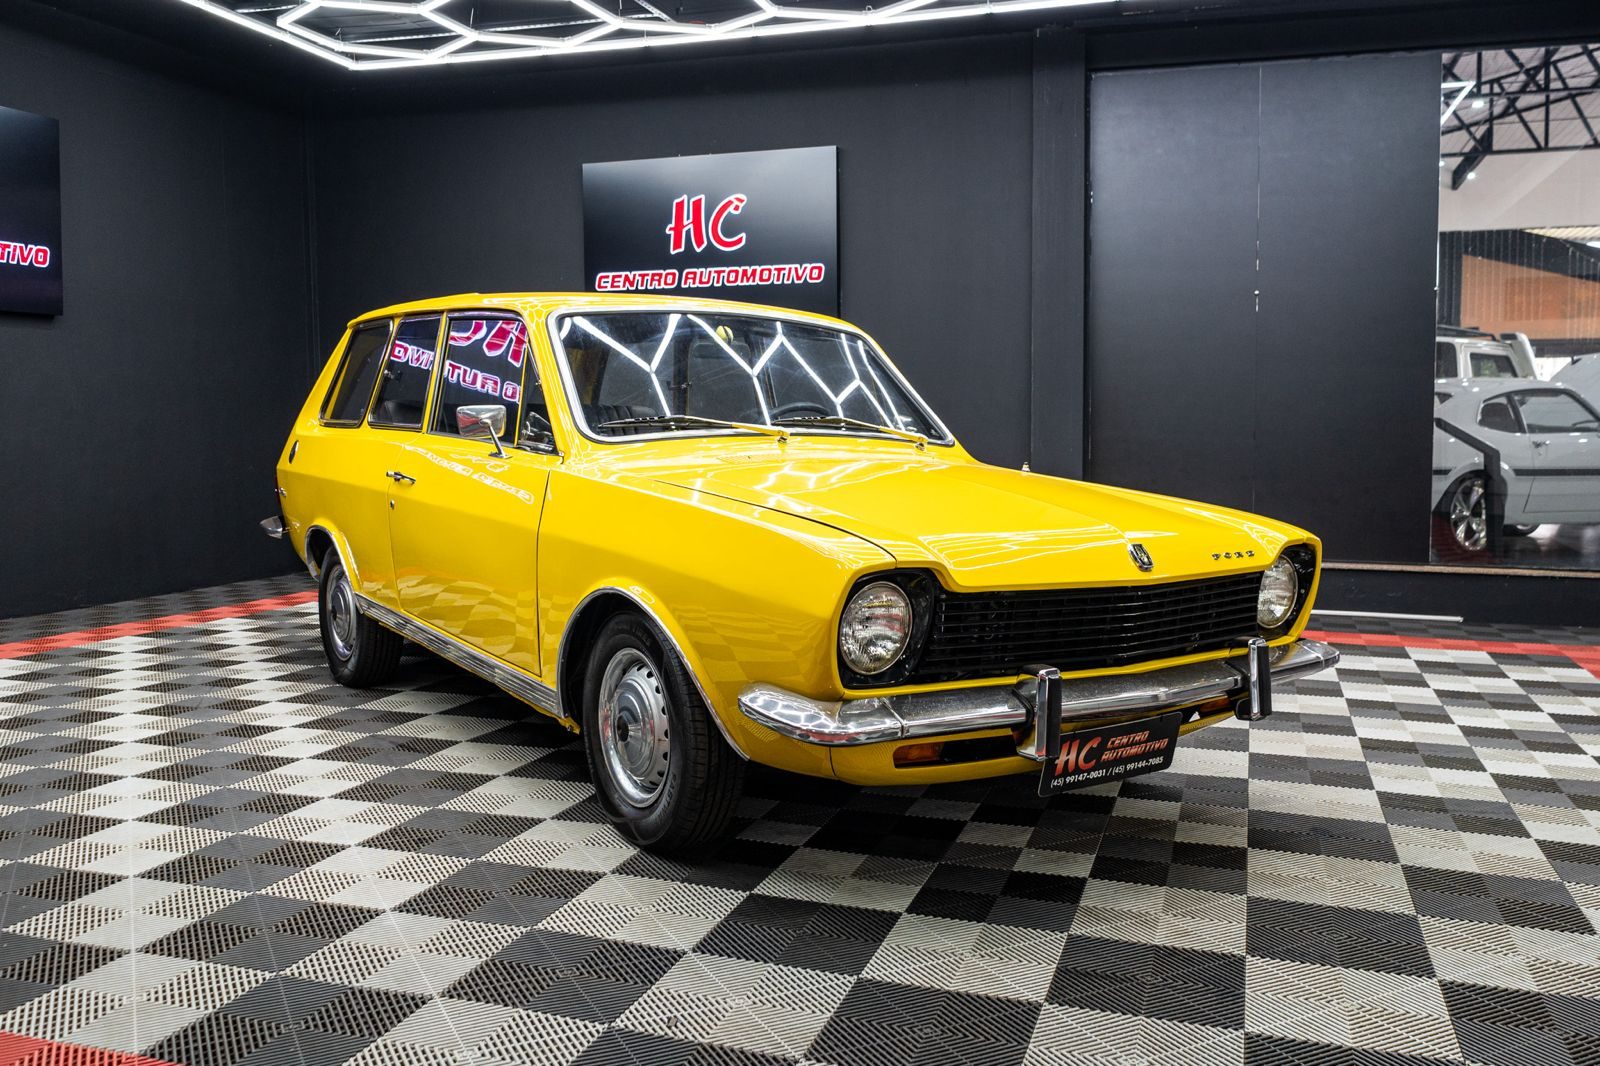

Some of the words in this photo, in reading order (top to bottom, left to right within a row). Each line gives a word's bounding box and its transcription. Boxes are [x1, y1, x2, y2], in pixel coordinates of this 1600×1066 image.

[666, 193, 747, 255] HC
[595, 269, 679, 291] CENTRO
[681, 263, 825, 289] AUTOMOTIVO
[1100, 738, 1169, 762] AUTOMOTIVO
[1107, 730, 1150, 749] CENTRO
[1055, 736, 1102, 776] HC
[1050, 777, 1065, 789] (45)
[1065, 769, 1106, 784] 99147-0031
[1112, 765, 1125, 775] (45)
